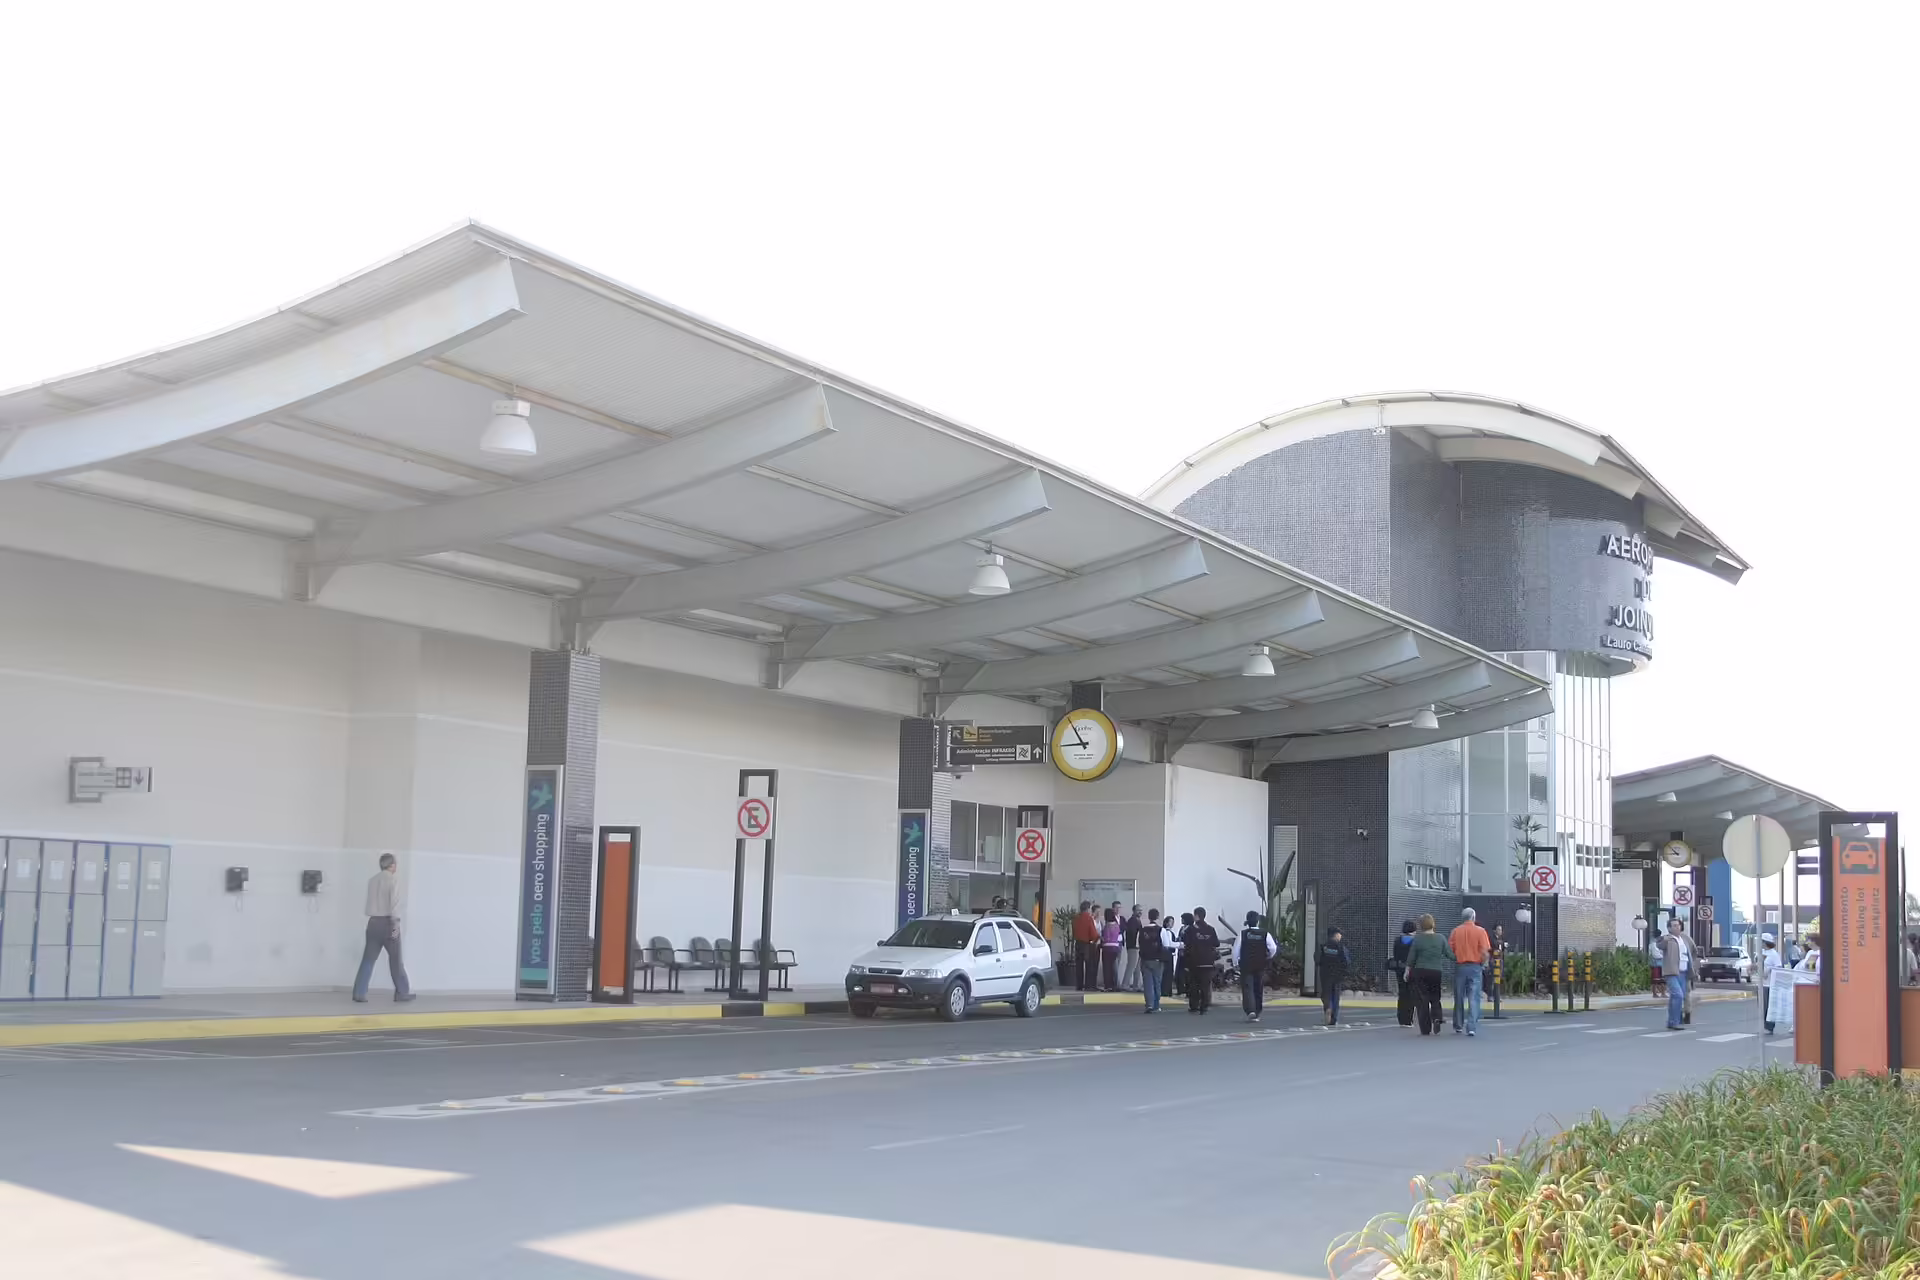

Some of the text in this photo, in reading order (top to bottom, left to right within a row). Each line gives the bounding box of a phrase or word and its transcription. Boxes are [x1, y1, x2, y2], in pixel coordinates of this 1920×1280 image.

[1607, 635, 1632, 650] Lauro
[532, 813, 549, 871] shopping
[533, 872, 544, 900] aero
[905, 846, 919, 892] shopping
[530, 904, 544, 934] pelo
[907, 892, 916, 915] aero
[1856, 887, 1866, 947] Parking lot
[1871, 887, 1880, 938] Parkplatz
[1840, 886, 1849, 983] Estacionamento
